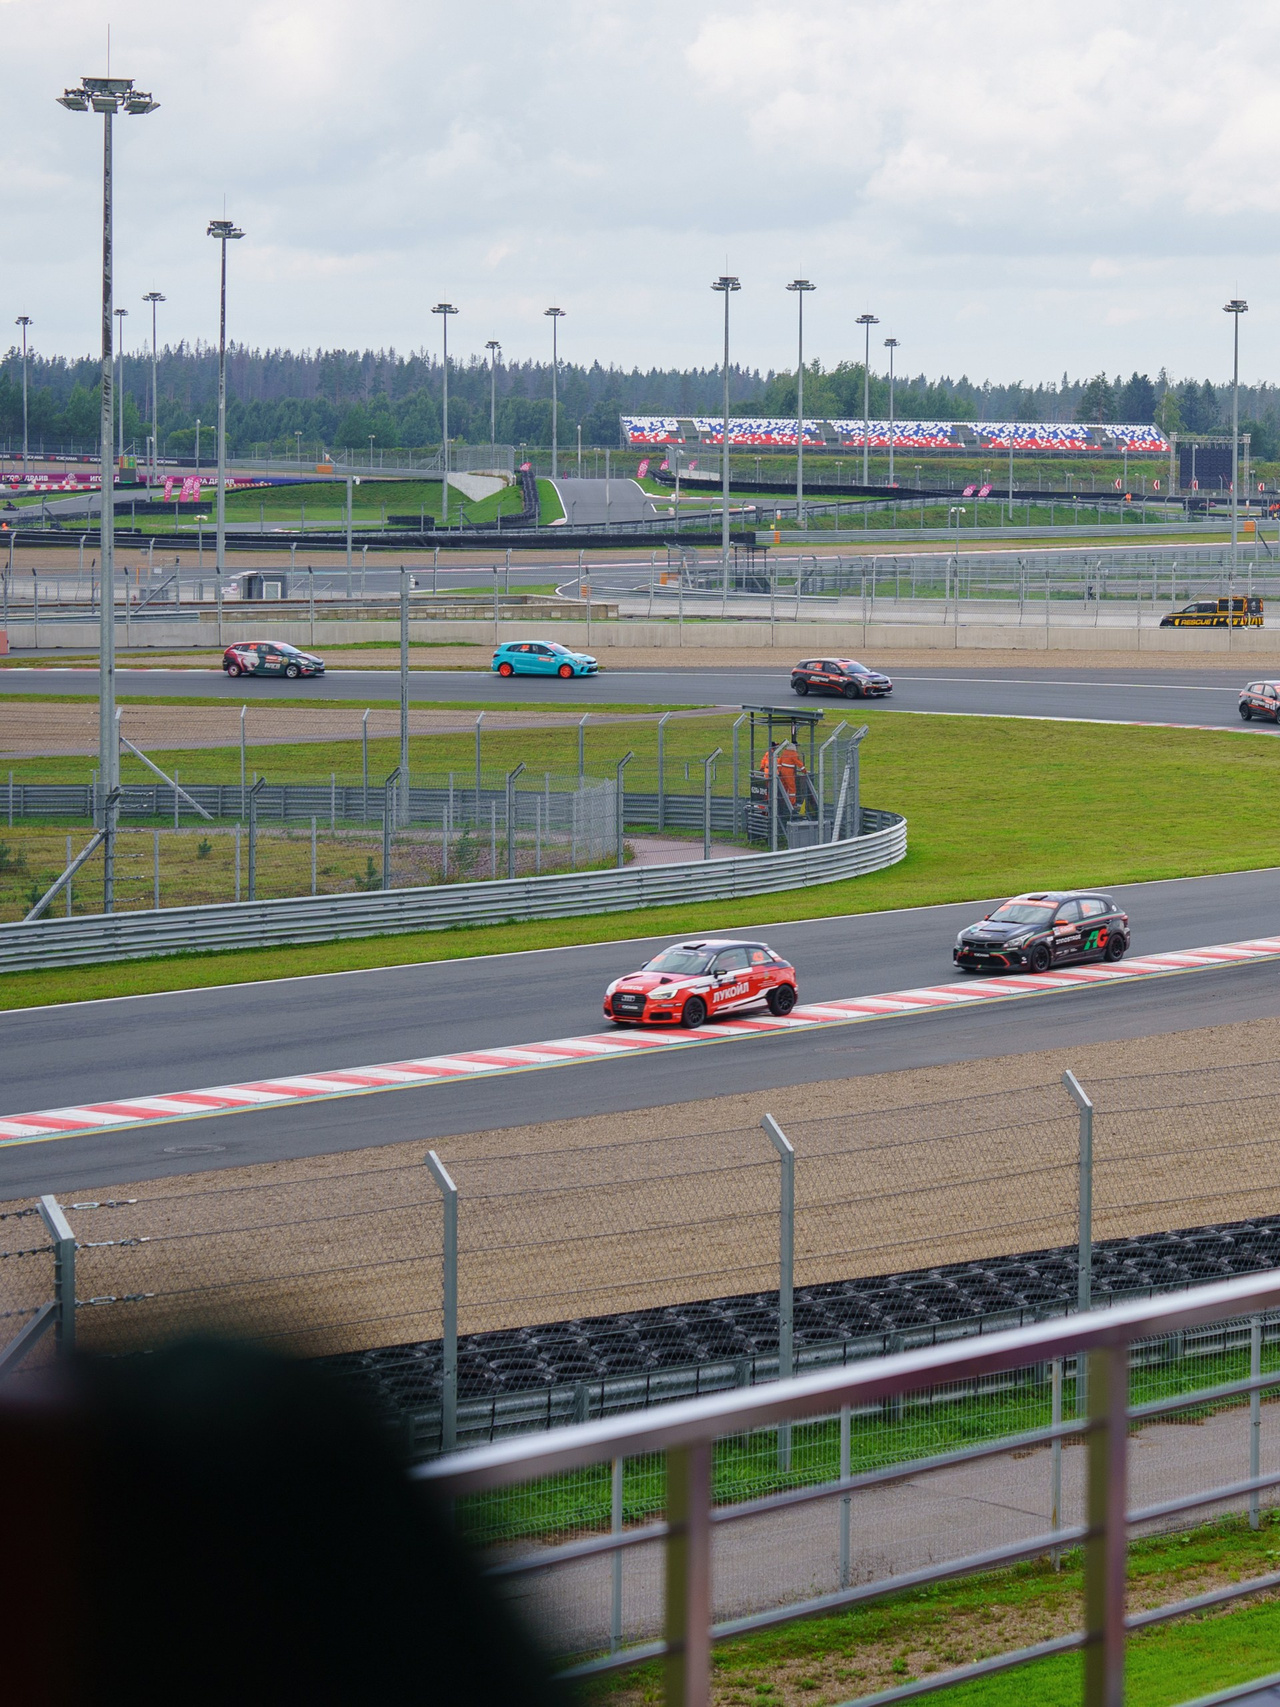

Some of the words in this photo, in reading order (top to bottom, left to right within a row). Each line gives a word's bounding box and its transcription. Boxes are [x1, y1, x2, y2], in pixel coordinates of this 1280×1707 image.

[1180, 618, 1212, 626] RESCUE
[1084, 928, 1109, 950] AG
[712, 982, 750, 1004] ЛУКОЙЛ
